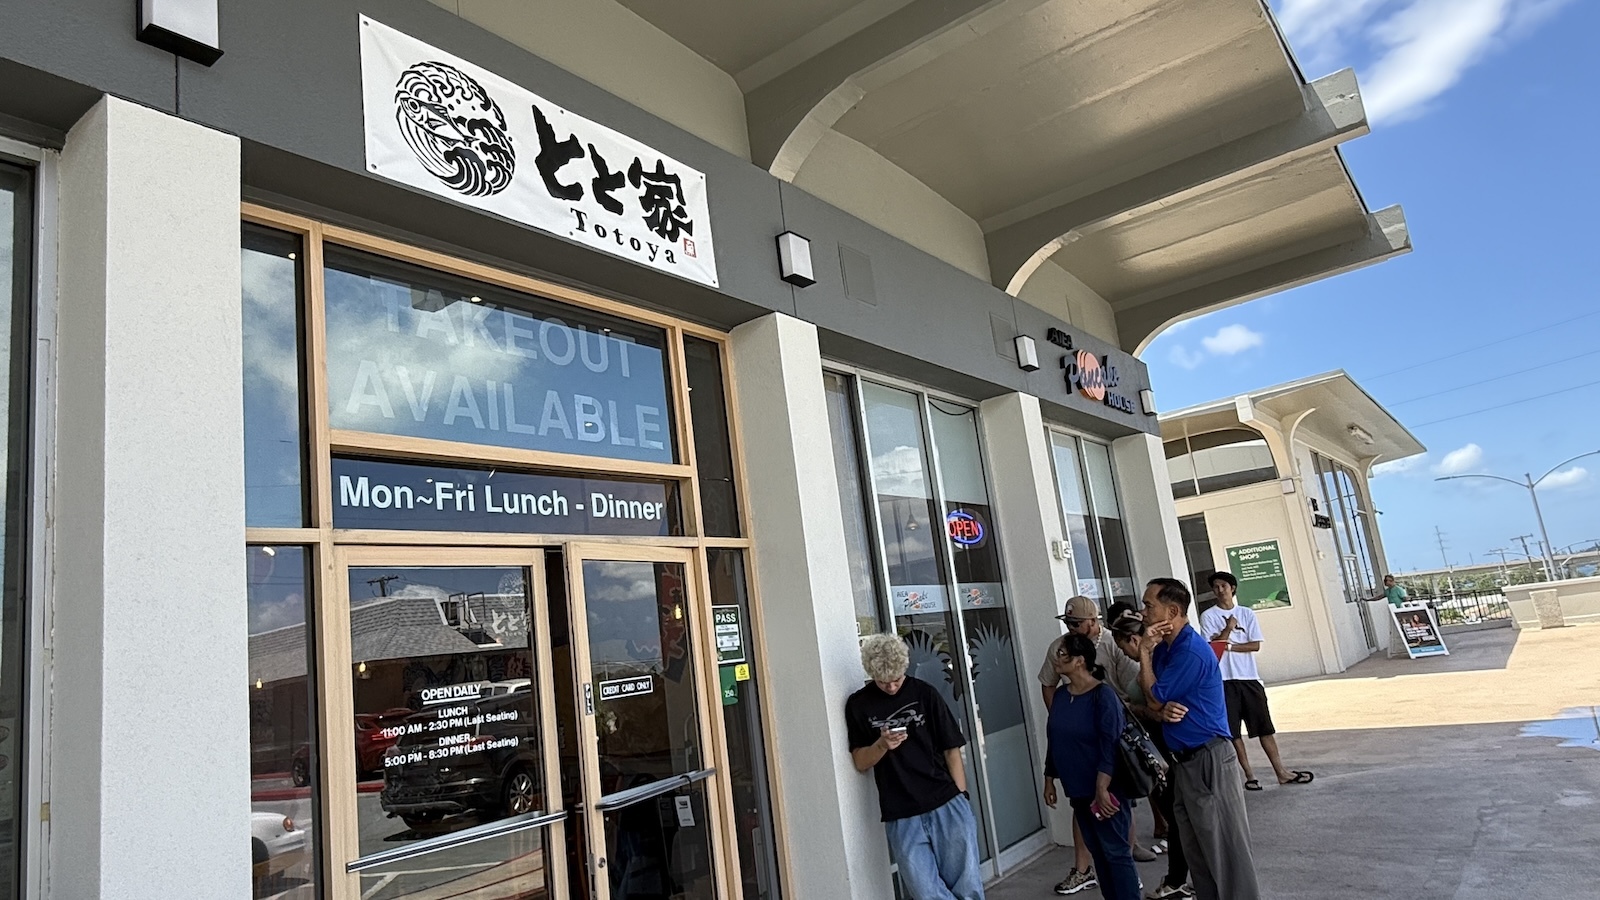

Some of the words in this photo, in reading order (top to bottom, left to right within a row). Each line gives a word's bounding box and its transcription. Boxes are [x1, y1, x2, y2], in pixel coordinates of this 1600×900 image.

[532, 104, 693, 242] とと家
[570, 207, 677, 264] Totoya
[370, 275, 636, 378] TAKEOUT
[345, 360, 665, 450] AVAILABLE
[1104, 391, 1136, 414] HOUSE
[339, 475, 476, 512] Mon~Fri
[485, 485, 569, 516] Lunch
[592, 492, 664, 521] Dinner
[948, 520, 979, 537] OPEN
[1238, 545, 1276, 555] ADDITIONAL
[1239, 553, 1260, 561] SHOPS
[715, 613, 736, 624] PASS
[421, 687, 452, 701] OPEN
[453, 684, 481, 697] DAILY
[603, 685, 620, 695] CREDIT
[621, 683, 635, 692] CARD
[637, 681, 650, 690] ONLY
[438, 706, 468, 718] LUNCH
[383, 726, 405, 738] 11:00
[407, 723, 422, 734] AM
[429, 720, 448, 731] 2:30
[449, 718, 463, 728] PM
[464, 715, 485, 727] (Last
[486, 710, 518, 722] Seating)
[439, 733, 471, 746] DINNER
[384, 755, 406, 767] 5:00
[408, 752, 422, 763] PM
[429, 749, 448, 759] 8:30
[449, 745, 464, 756] PM
[464, 743, 485, 755] (Last
[486, 736, 519, 749] Seating)
